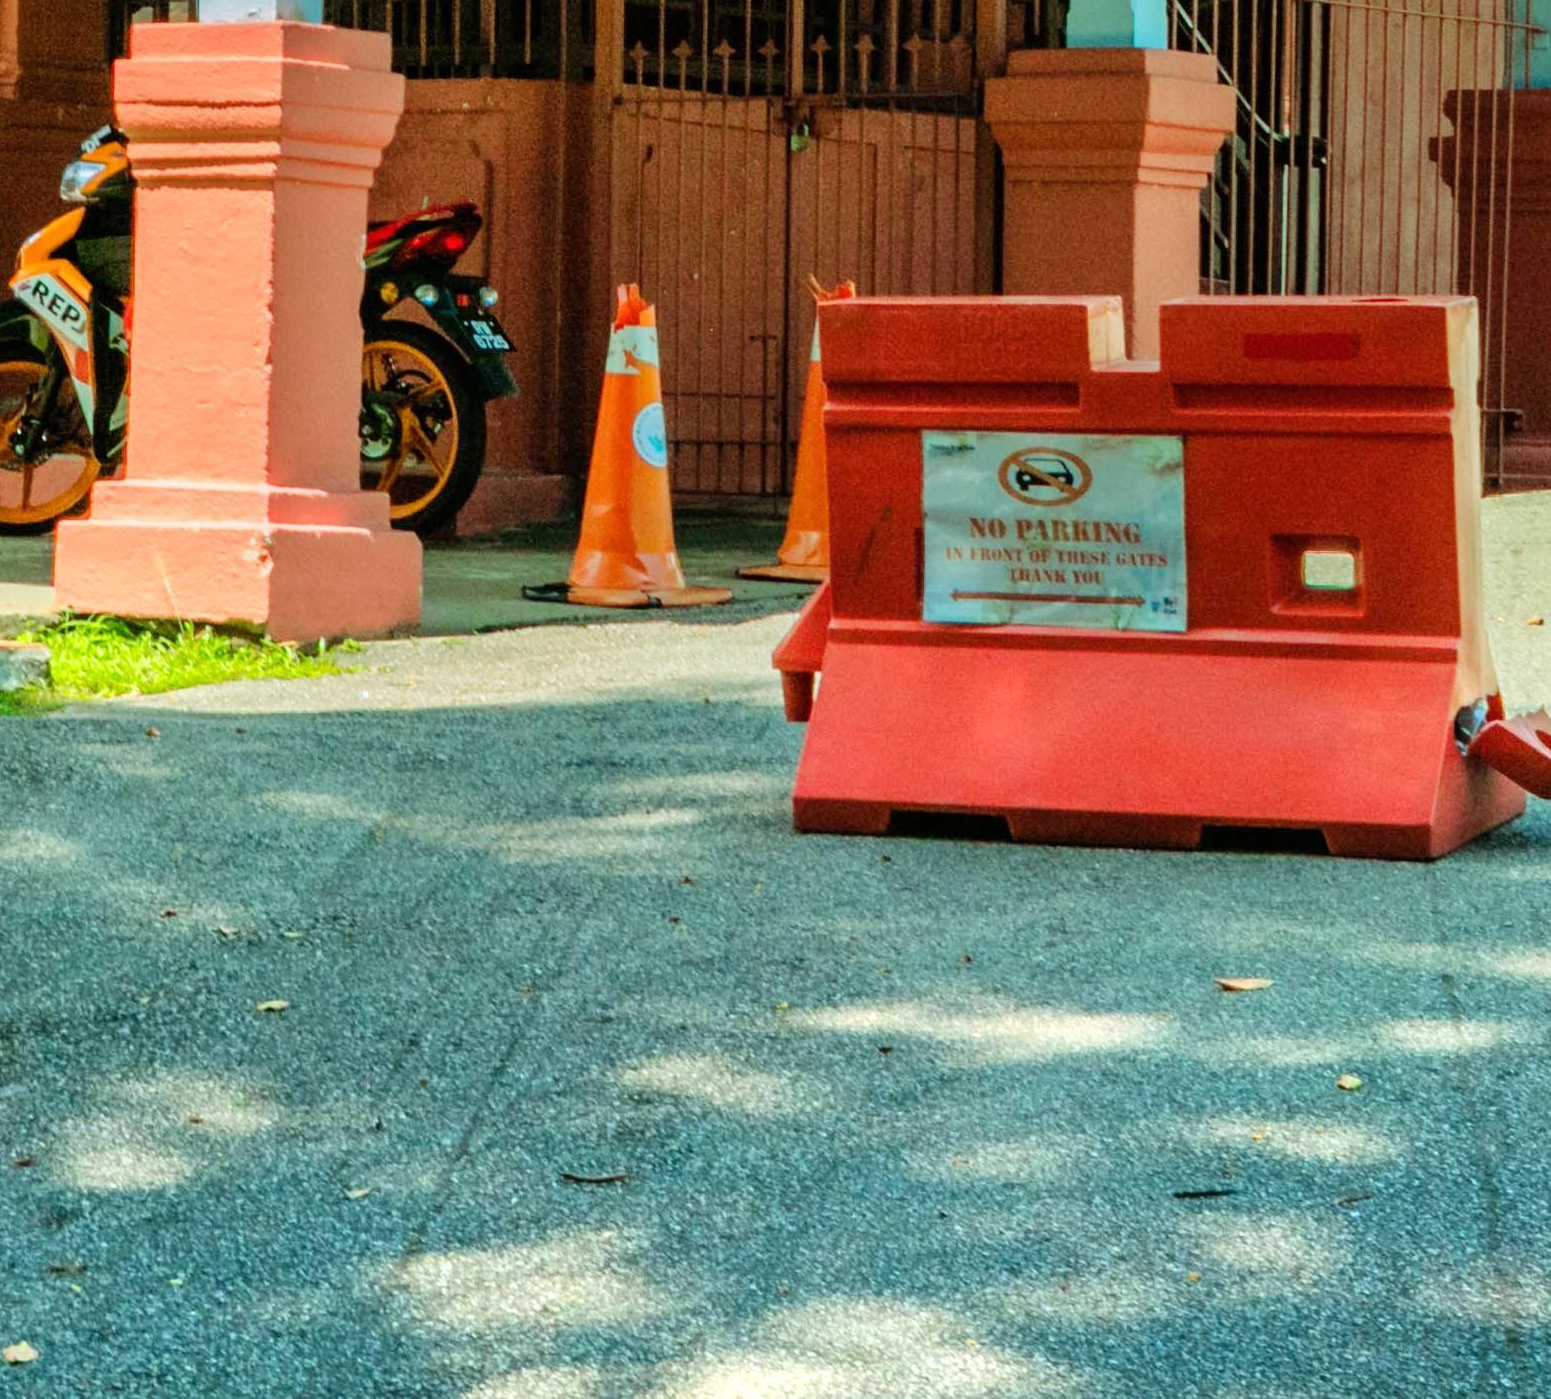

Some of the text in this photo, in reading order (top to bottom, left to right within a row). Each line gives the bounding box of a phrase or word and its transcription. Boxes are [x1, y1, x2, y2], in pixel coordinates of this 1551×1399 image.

[969, 517, 1141, 545] NO PARKING
[946, 546, 1168, 568] IN FRONT OF THESE GATES
[1008, 568, 1104, 585] THANK YOU
